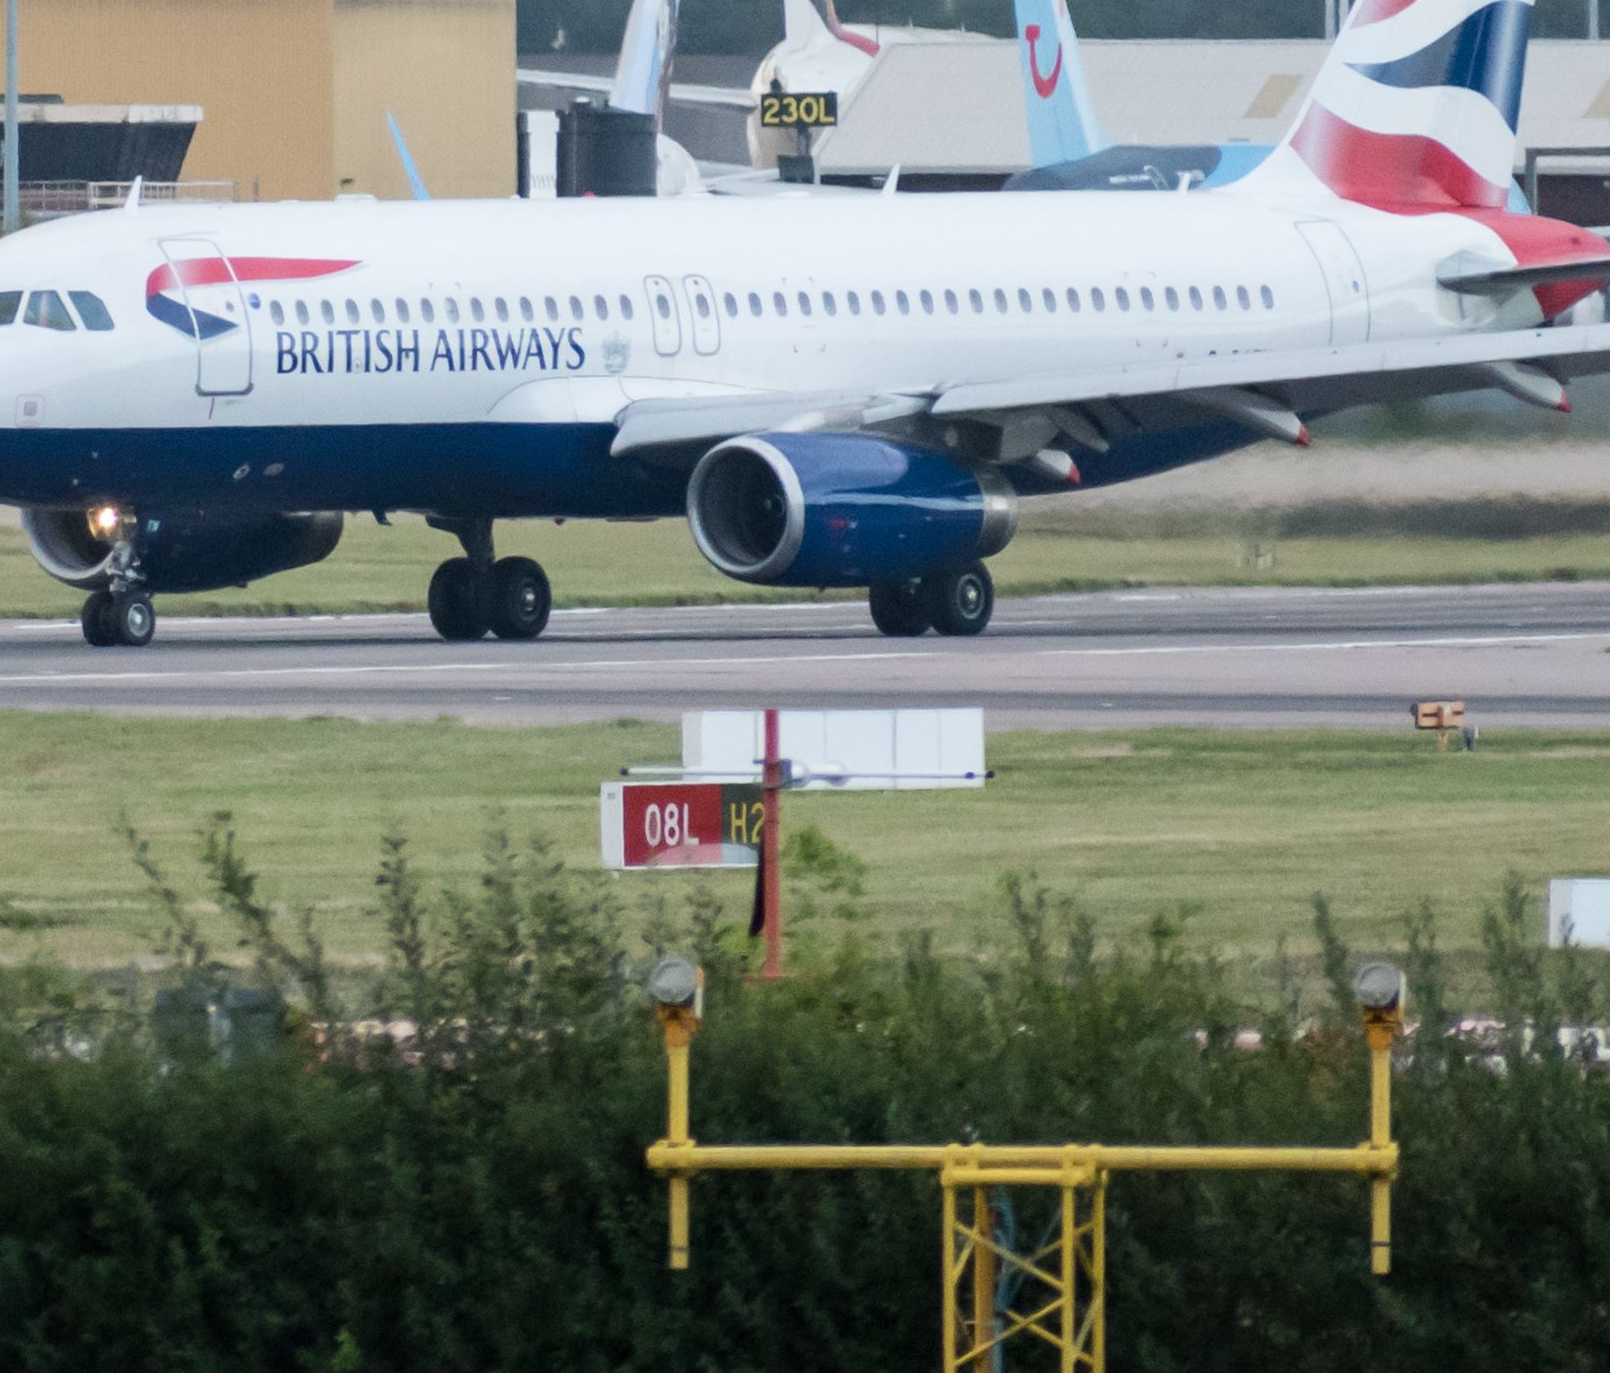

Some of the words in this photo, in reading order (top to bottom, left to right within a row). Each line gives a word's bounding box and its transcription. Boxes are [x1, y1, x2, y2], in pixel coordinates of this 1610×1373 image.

[763, 96, 835, 124] 230L
[276, 329, 420, 374] BRITISH
[430, 327, 586, 372] AIRWAYS
[644, 802, 700, 847] 08L
